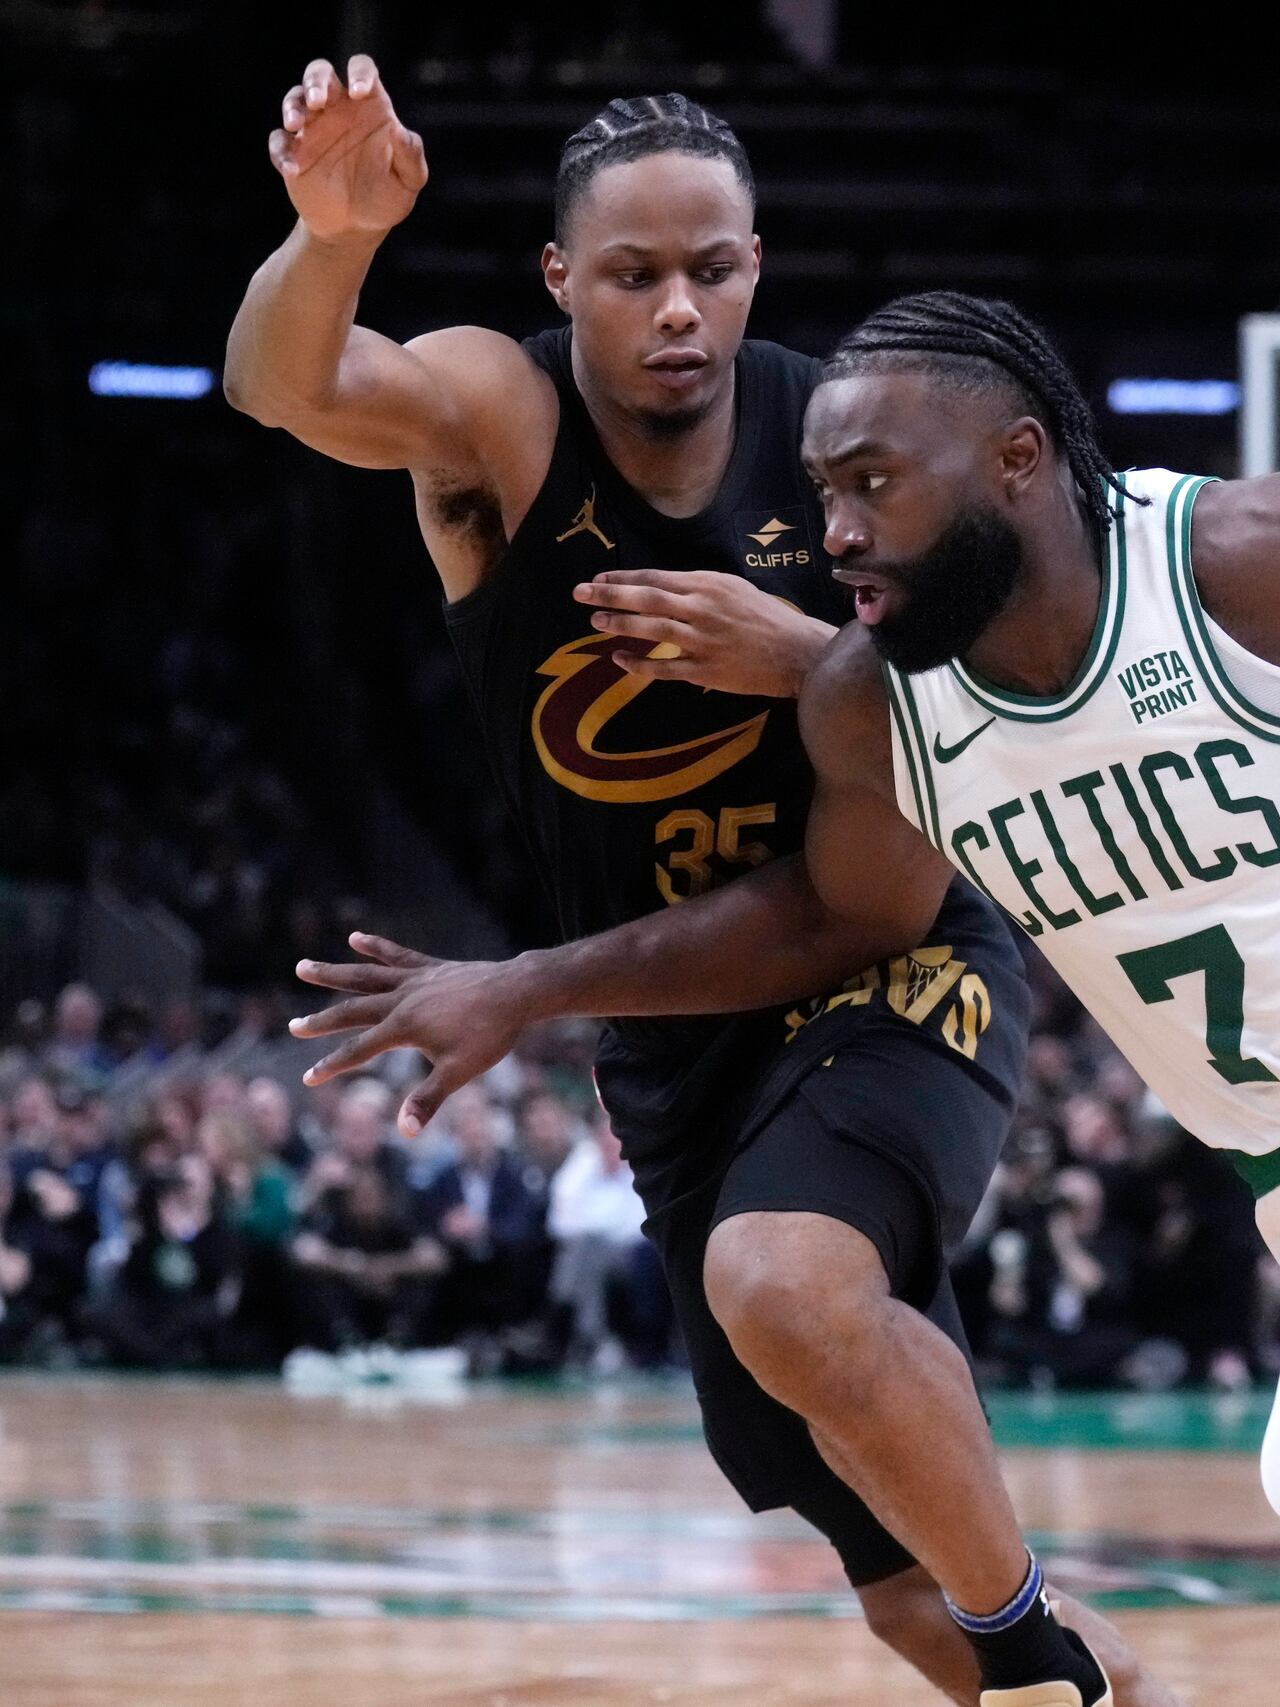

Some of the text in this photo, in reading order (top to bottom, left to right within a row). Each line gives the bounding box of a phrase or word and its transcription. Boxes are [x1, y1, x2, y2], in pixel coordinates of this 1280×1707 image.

[745, 549, 810, 567] CLIFFS
[1117, 650, 1190, 700] VISTA
[1130, 679, 1197, 724] PRINT
[654, 802, 777, 906] 35
[1115, 922, 1280, 1085] 7
